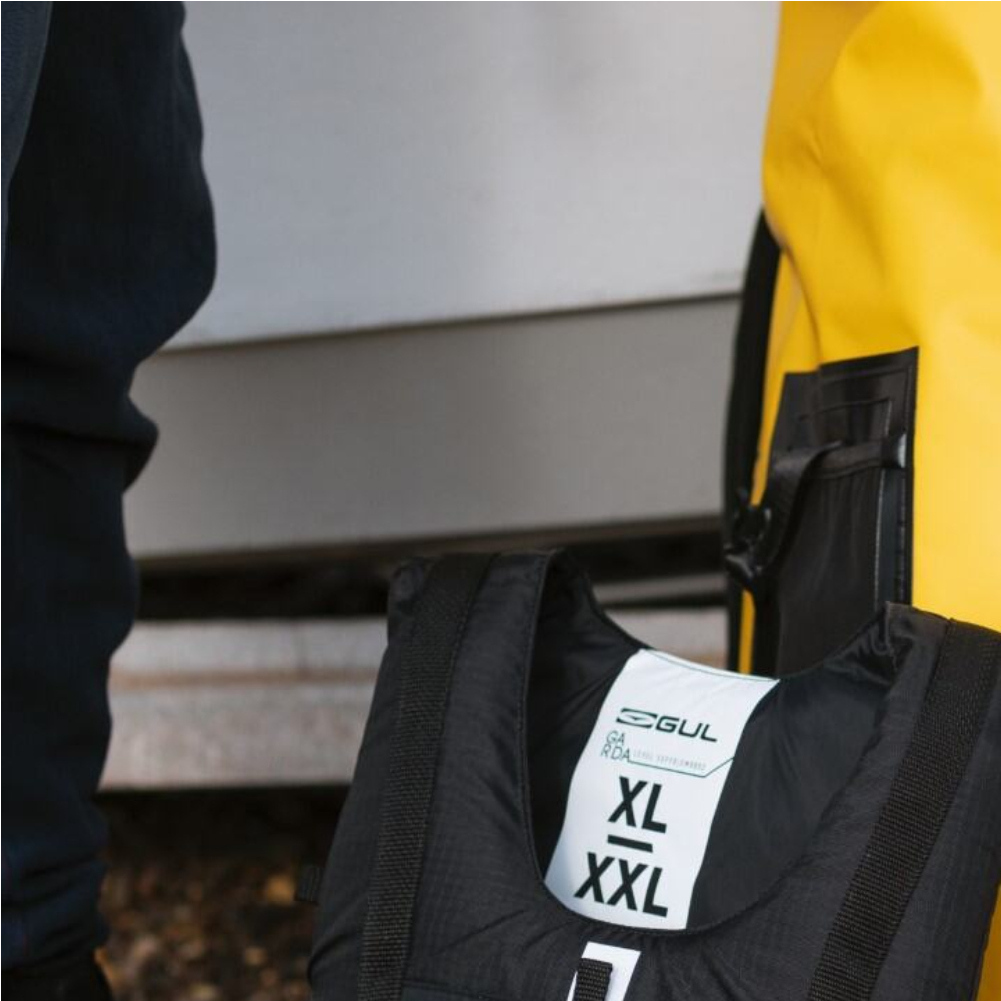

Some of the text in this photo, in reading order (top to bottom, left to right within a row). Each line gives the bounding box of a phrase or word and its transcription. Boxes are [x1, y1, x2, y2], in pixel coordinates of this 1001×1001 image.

[606, 730, 625, 746] GA
[656, 715, 717, 742] GUL
[608, 776, 667, 833] XL
[574, 852, 669, 918] XXL
